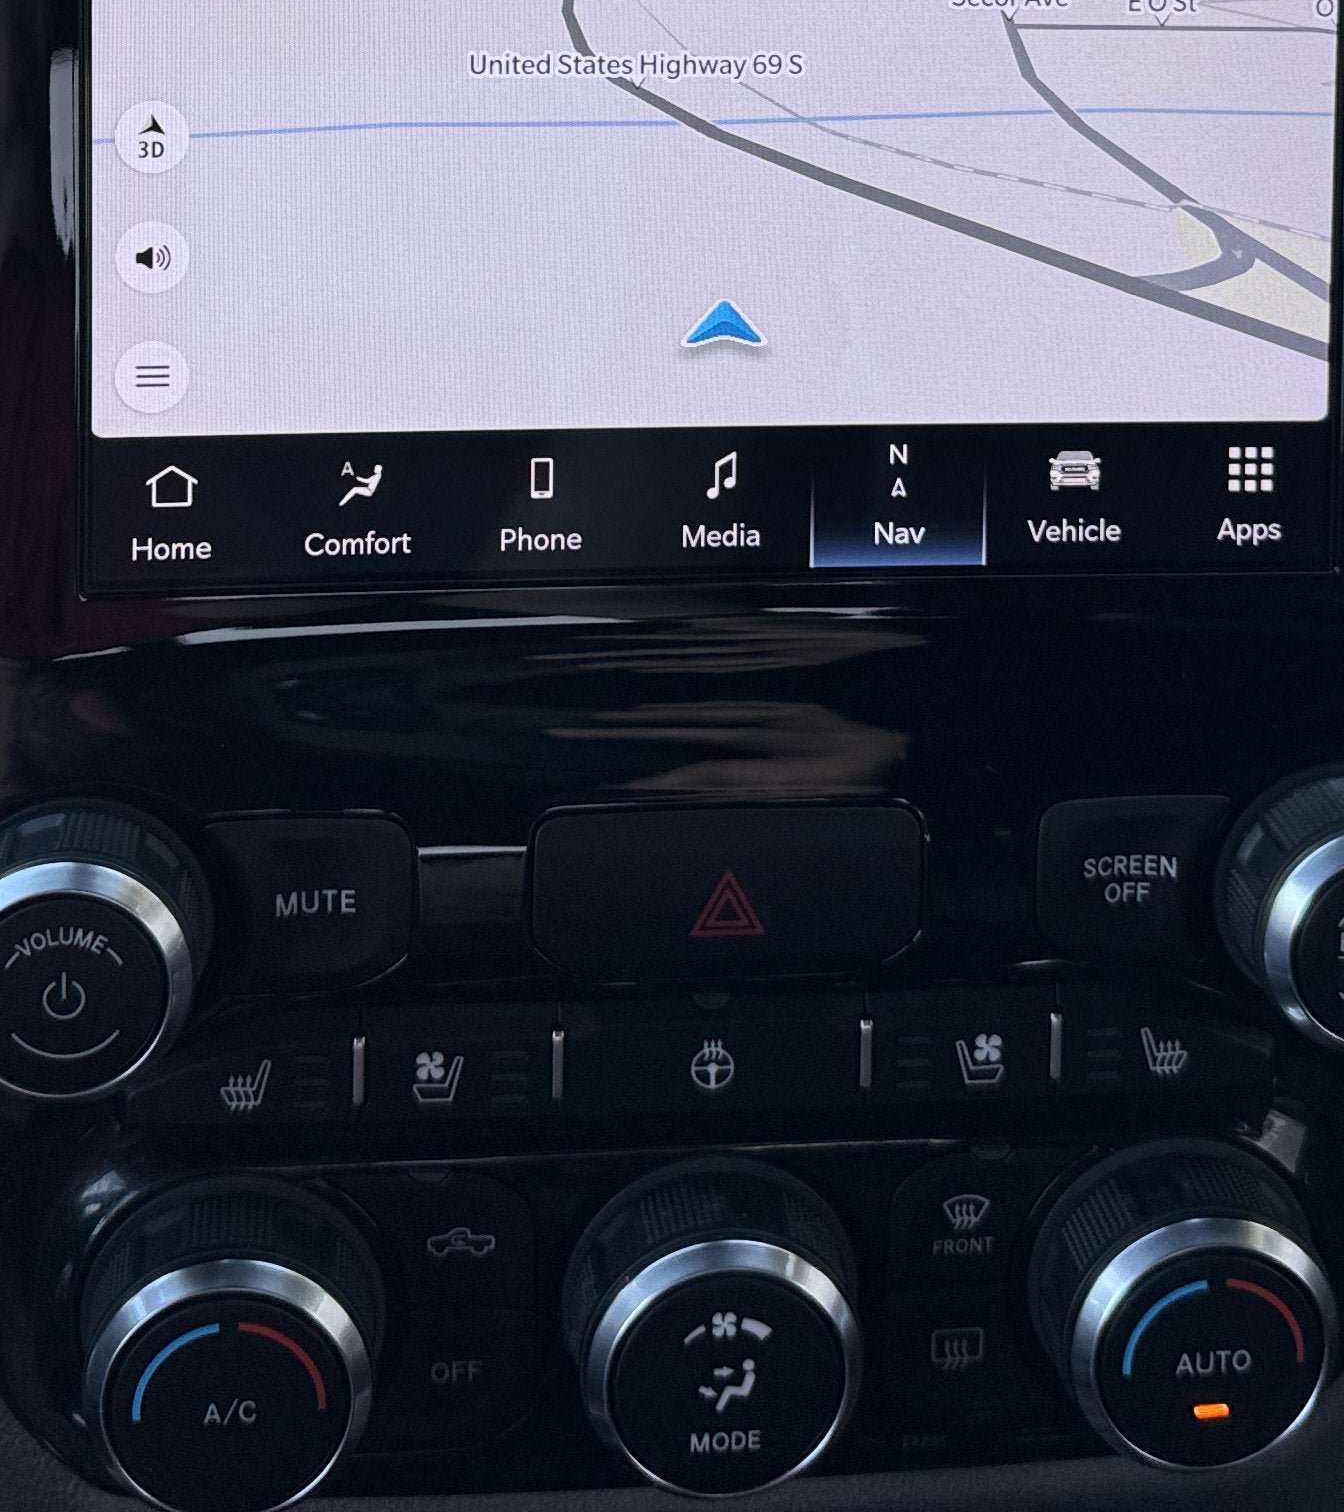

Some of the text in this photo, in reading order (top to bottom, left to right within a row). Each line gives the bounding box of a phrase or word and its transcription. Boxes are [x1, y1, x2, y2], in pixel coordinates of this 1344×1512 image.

[471, 53, 802, 80] United States Highway 69 S
[139, 141, 164, 158] 3D
[890, 444, 907, 464] N
[501, 528, 582, 551] Phone
[683, 523, 760, 547] Media
[875, 522, 925, 544] Nav
[1027, 518, 1121, 542] Vehicle
[1217, 518, 1281, 543] Apps
[132, 538, 211, 561] Home
[305, 530, 411, 556] Comfort
[1084, 855, 1177, 878] SCREEN
[276, 890, 356, 916] MUTE
[1105, 882, 1150, 903] OFF
[14, 926, 109, 957] VOLUME
[933, 1236, 993, 1254] FRONT
[431, 1360, 481, 1384] OFF
[1176, 1349, 1251, 1375] AUTO
[204, 1399, 256, 1424] A/C
[690, 1430, 760, 1452] MODE
